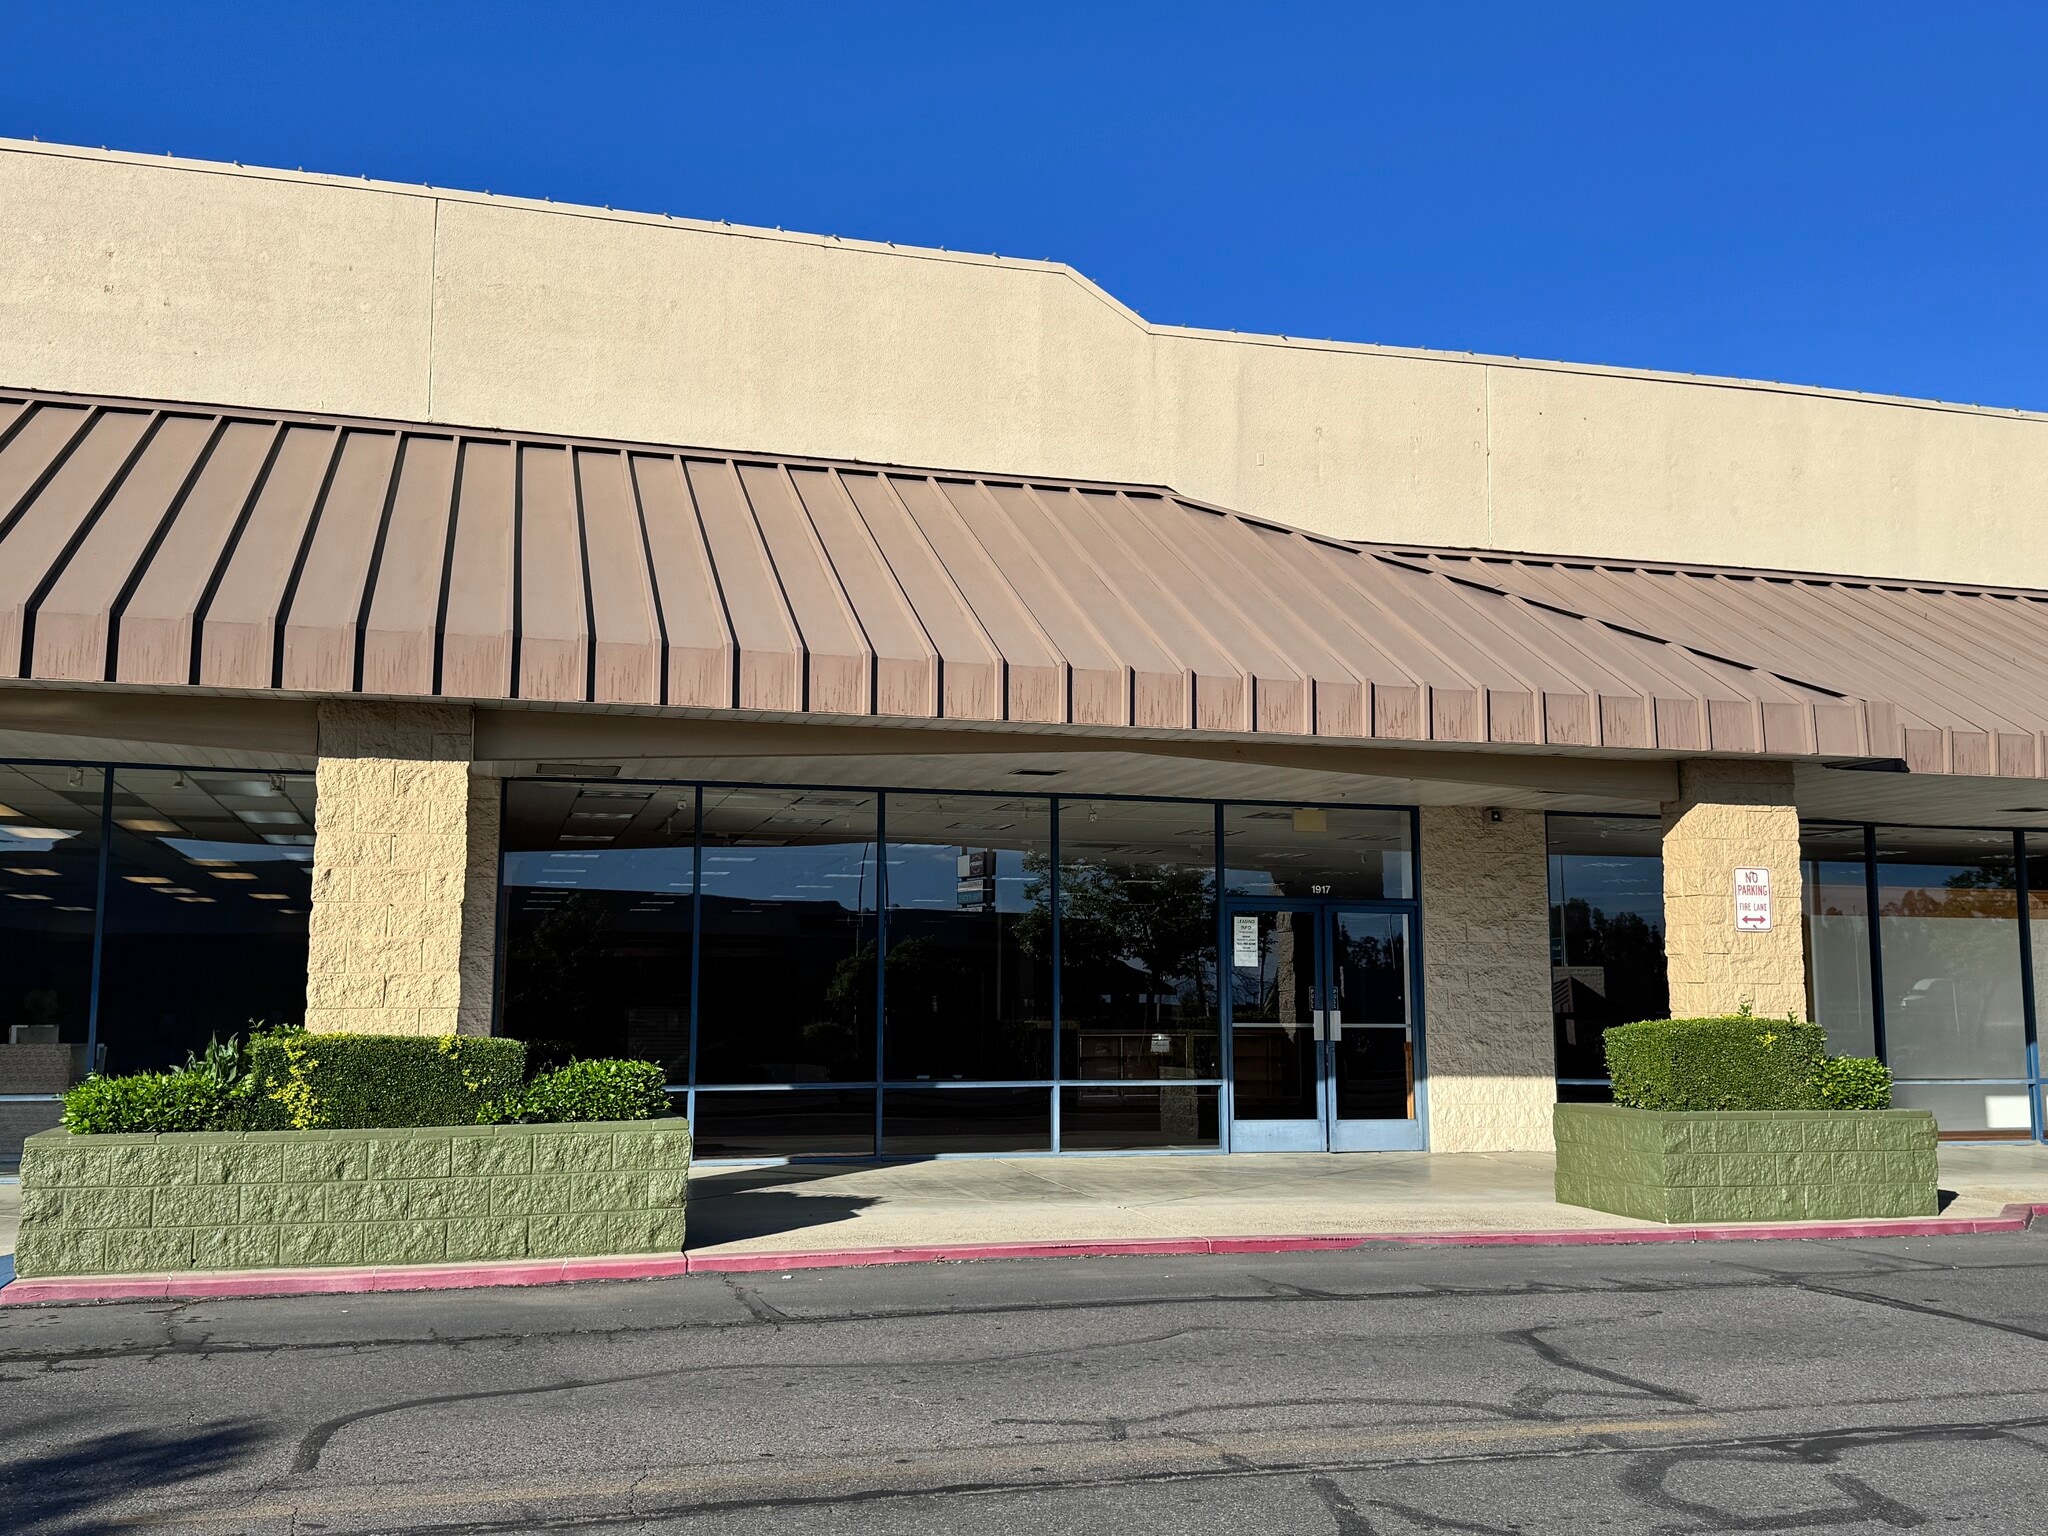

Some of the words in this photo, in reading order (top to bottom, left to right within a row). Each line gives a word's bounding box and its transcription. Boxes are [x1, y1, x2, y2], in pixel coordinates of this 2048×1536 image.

[1745, 871, 1758, 883] NO
[1311, 885, 1331, 894] 1917
[1737, 885, 1768, 896] PARKING
[1739, 903, 1752, 911] FIRE
[1753, 903, 1768, 911] LANE
